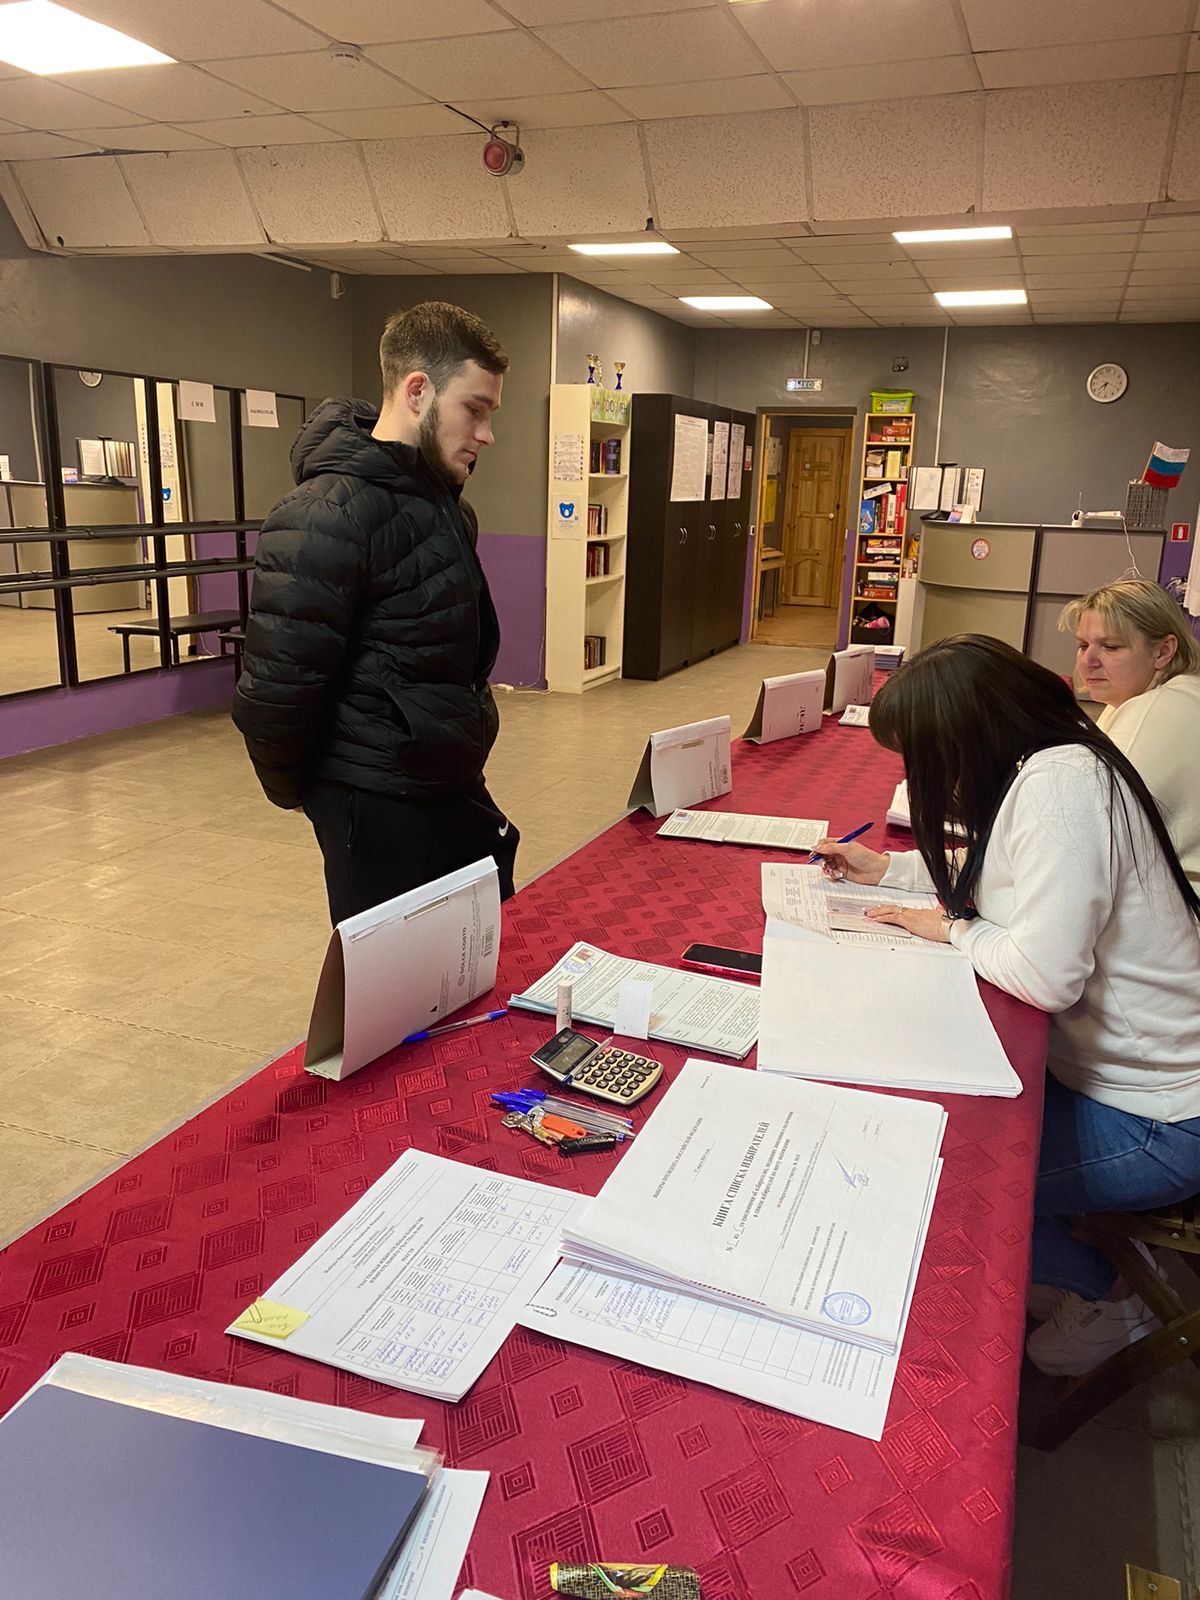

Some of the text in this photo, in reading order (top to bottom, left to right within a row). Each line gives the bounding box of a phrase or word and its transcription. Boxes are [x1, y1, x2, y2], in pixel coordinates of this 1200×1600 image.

[713, 1122, 769, 1227] КНИГА СПИСКА ИЗБИРАТЕЛЕЙ
